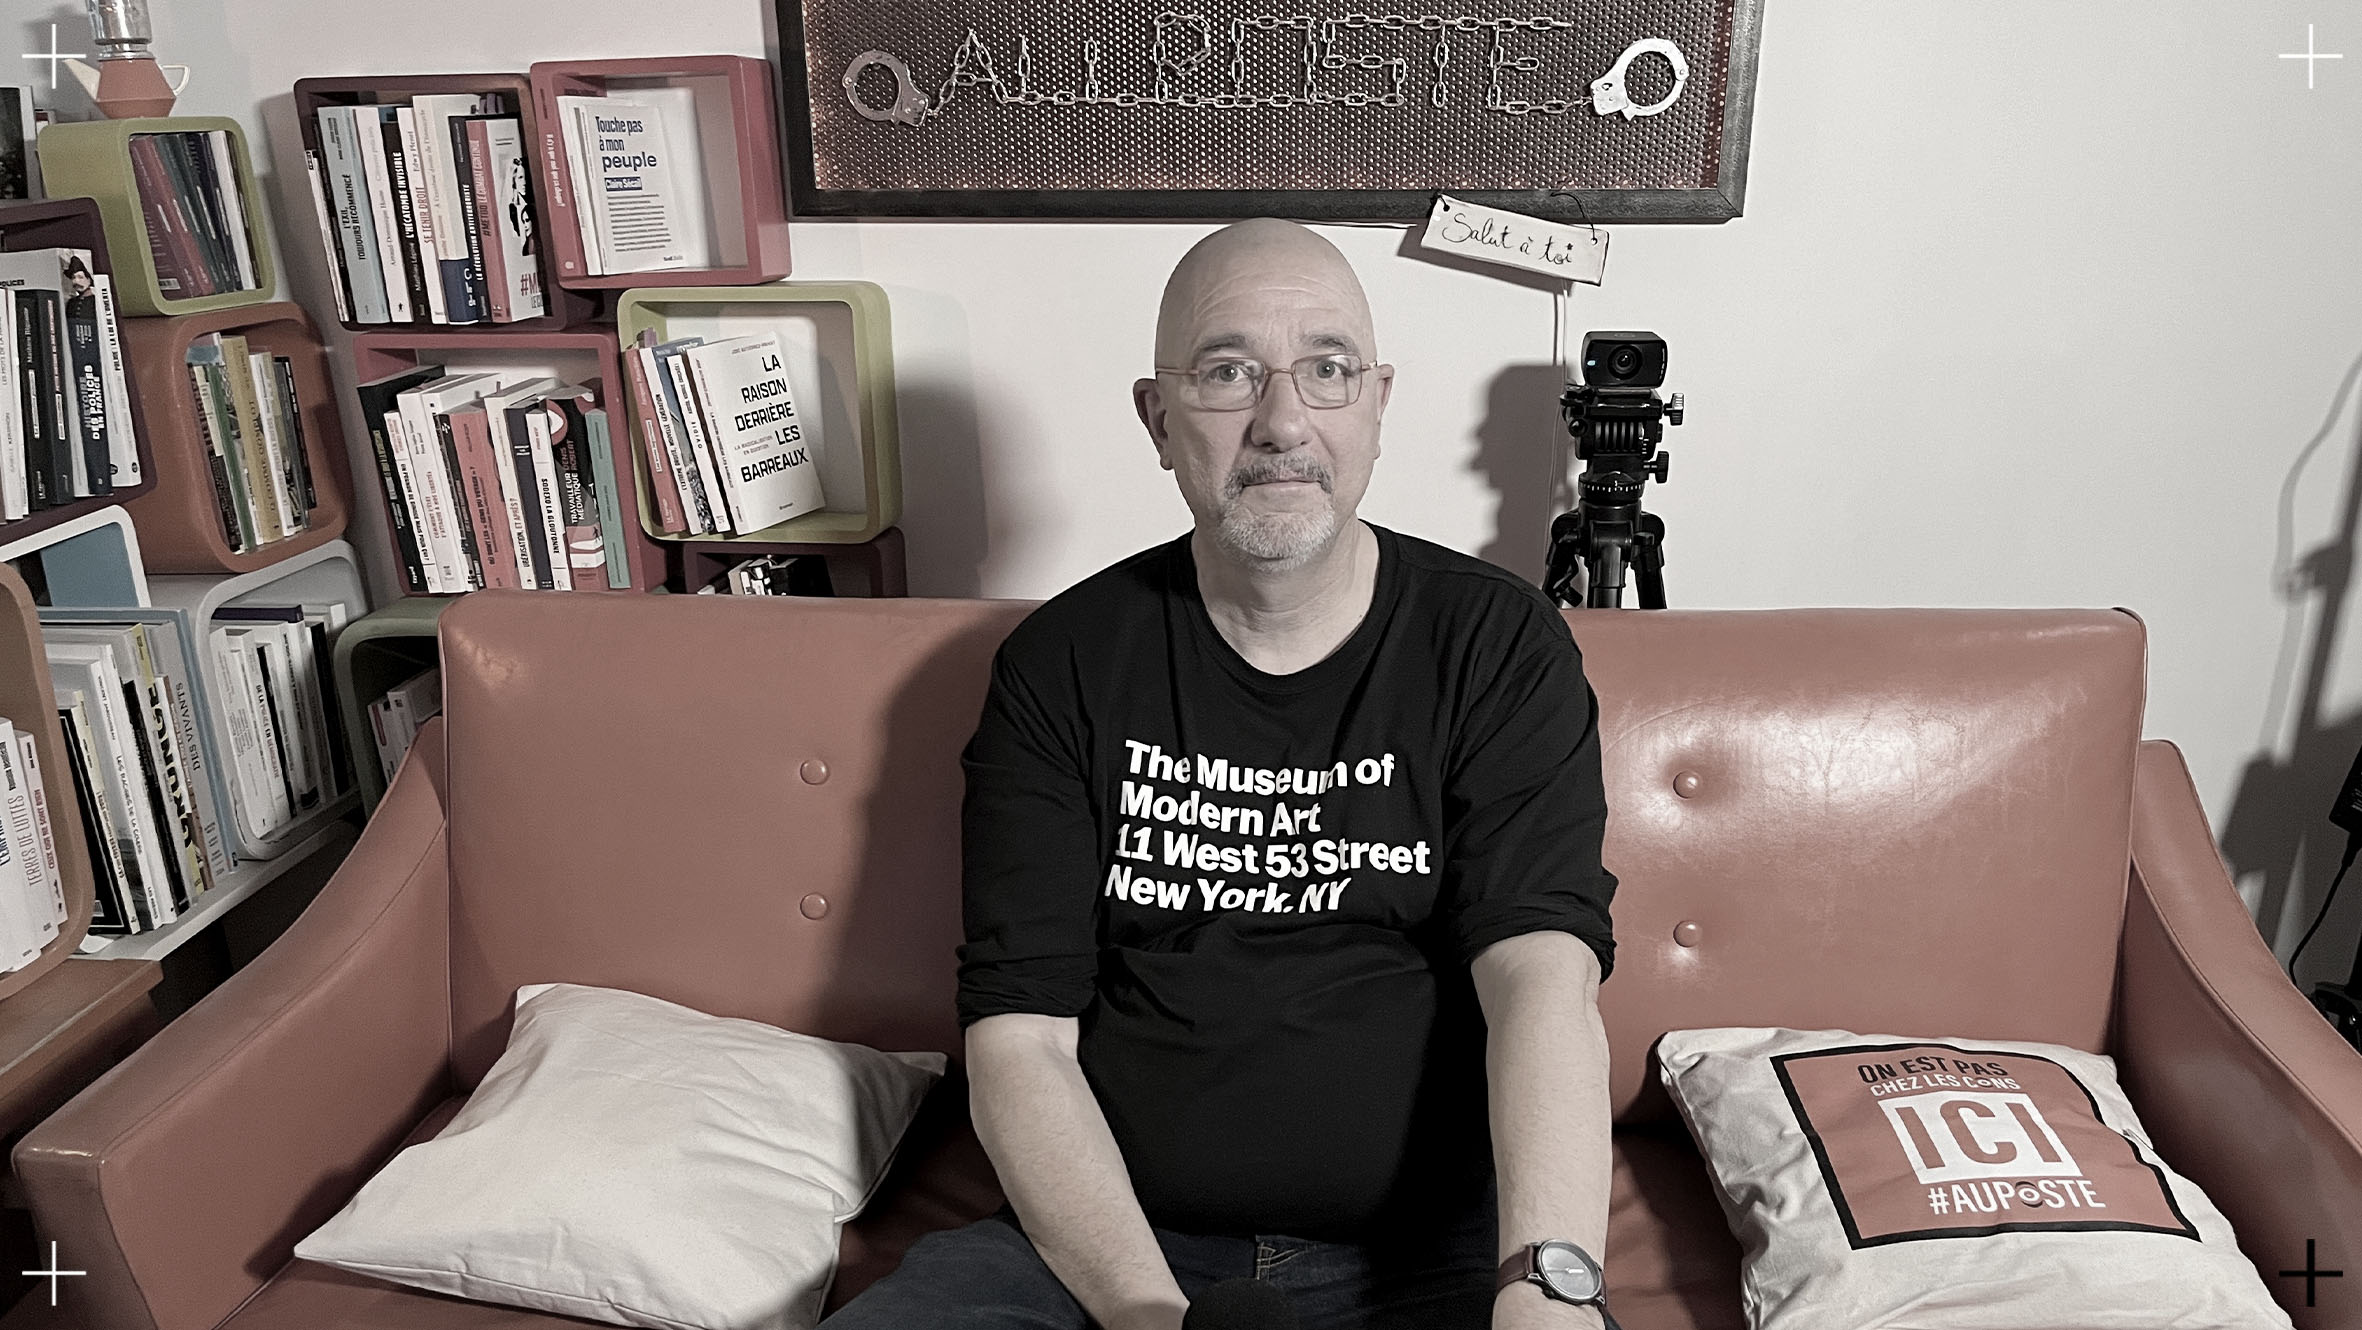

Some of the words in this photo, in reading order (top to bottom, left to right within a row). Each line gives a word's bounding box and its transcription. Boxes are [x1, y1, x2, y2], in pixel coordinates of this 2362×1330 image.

[595, 116, 626, 133] Touche
[627, 119, 643, 136] pas
[599, 135, 605, 151] à
[606, 139, 624, 151] mon
[392, 151, 406, 188] INVISIBLE
[602, 151, 657, 172] peuple
[397, 189, 414, 239] L'HÉCATOMBE
[415, 186, 427, 209] DROIT
[419, 210, 431, 232] TENIR
[351, 225, 366, 260] TOUJOURS
[423, 234, 432, 243] SE
[1442, 213, 1513, 249] Salut
[1519, 236, 1532, 255] à
[1539, 236, 1573, 264] toi
[762, 354, 781, 372] LA
[83, 364, 98, 414] POLICES
[92, 375, 104, 414] FRANCE
[741, 378, 787, 403] RAISON
[90, 416, 100, 440] DES
[735, 401, 794, 431] DERRIÈRE
[690, 420, 703, 449] OVIDIE
[775, 425, 801, 445] LES
[566, 438, 577, 471] ROBERT
[741, 448, 808, 482] BARREAUX
[540, 477, 551, 504] SODEXO
[564, 471, 578, 523] TRAVAILLEUR
[570, 472, 584, 520] MÉDIATIQUE
[544, 505, 552, 514] LA
[546, 515, 559, 554] GLOUTONNE
[174, 681, 195, 742] VIVANTS
[187, 742, 201, 771] DES
[1125, 740, 1191, 784] The
[1196, 753, 1348, 796] Museum
[1354, 753, 1395, 787] of
[6, 793, 31, 832] LUTTES
[1120, 781, 1264, 837] Modern
[1270, 802, 1322, 837] Art
[17, 832, 34, 847] DE
[1115, 823, 1154, 862] 11
[1163, 829, 1260, 875] West
[1265, 842, 1309, 878] 53
[1313, 837, 1432, 875] Street
[21, 846, 43, 886] TERRES
[1104, 863, 1191, 911] New
[1298, 877, 1351, 914] NY
[1856, 1064, 1896, 1084] ON
[1902, 1056, 1946, 1076] EST
[1956, 1058, 2010, 1077] PAS
[1869, 1077, 1922, 1097] CHEZ
[1923, 1074, 1960, 1090] LES
[1963, 1076, 2022, 1091] CONS
[1894, 1100, 2062, 1170] ICI
[1927, 1178, 2106, 1216] #AUPOSTE
